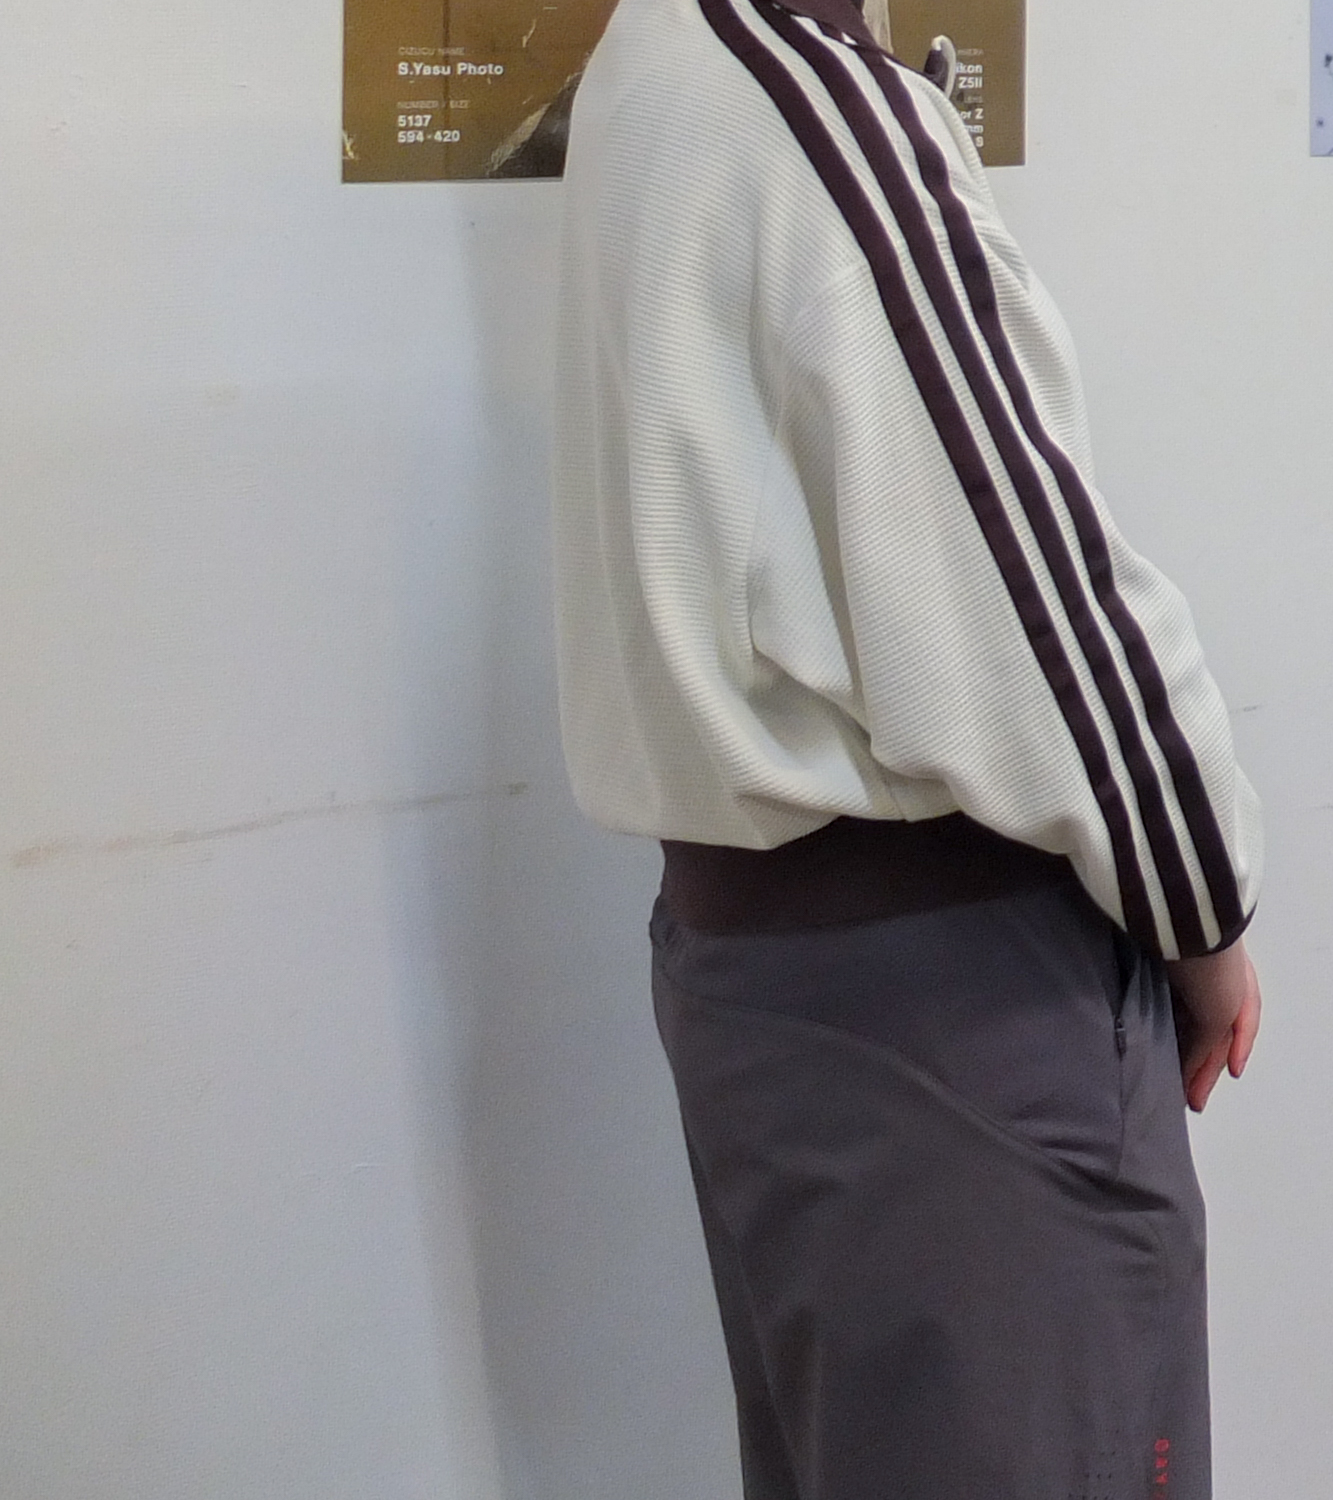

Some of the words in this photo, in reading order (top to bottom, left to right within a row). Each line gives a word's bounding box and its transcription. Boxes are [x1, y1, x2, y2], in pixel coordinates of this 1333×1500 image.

[398, 62, 451, 76] S.Yasu
[456, 62, 504, 75] Photo
[955, 62, 983, 74] ikon
[975, 107, 984, 120] Z
[398, 114, 432, 127] 5137
